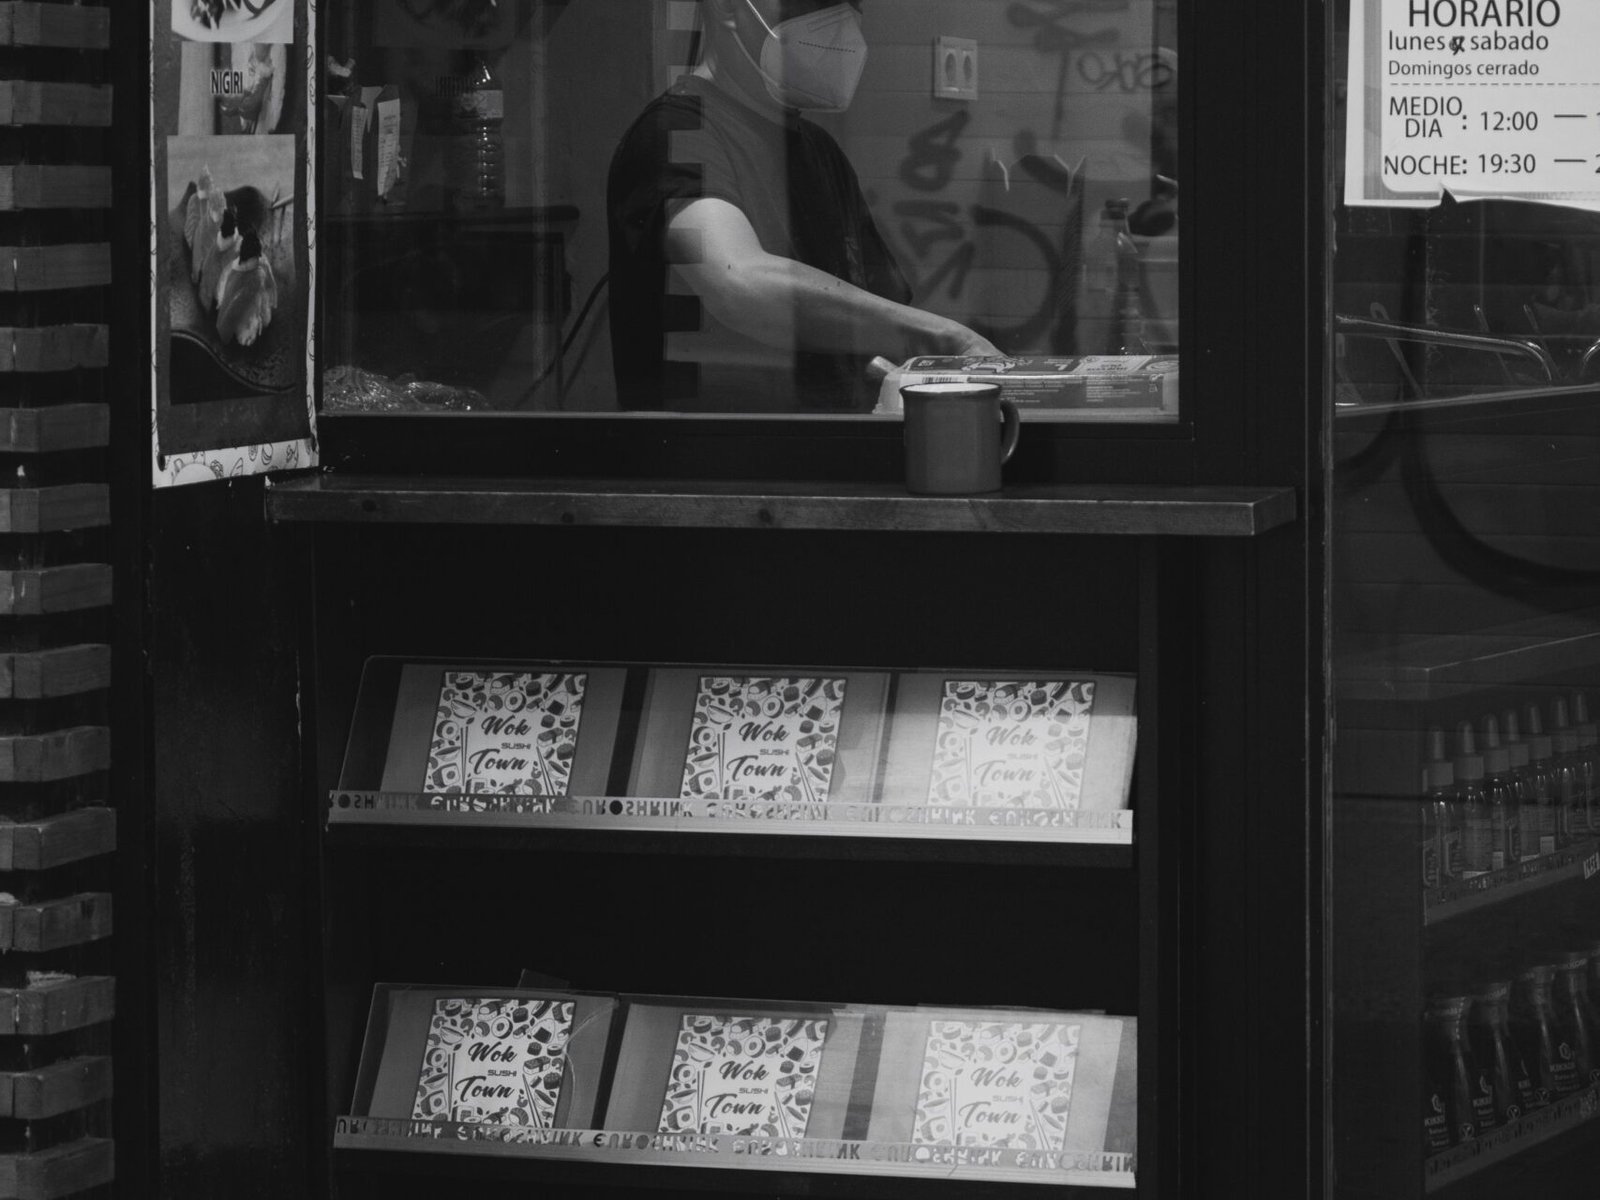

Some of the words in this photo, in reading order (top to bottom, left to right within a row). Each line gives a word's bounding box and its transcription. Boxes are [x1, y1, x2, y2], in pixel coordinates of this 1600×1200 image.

[1388, 29, 1446, 51] lunes
[1470, 29, 1550, 51] sabado
[1388, 59, 1472, 80] Domingos
[1477, 59, 1540, 76] cerrado
[211, 70, 244, 95] NIGIRI
[1389, 95, 1463, 116] MEDIO
[1405, 118, 1443, 138] DIA
[1480, 111, 1539, 131] 12:00
[1478, 153, 1536, 174] 19:30
[481, 714, 532, 736] Wok
[739, 720, 790, 742] Wok
[986, 724, 1038, 746] Wok
[468, 748, 529, 775] Town
[726, 754, 787, 782] Town
[974, 759, 1035, 787] Town
[467, 1041, 518, 1063] Wok
[718, 1059, 770, 1081] Wok
[970, 1066, 1024, 1088] Wok
[454, 1075, 515, 1102] Town
[704, 1093, 766, 1119] Town
[958, 1101, 1022, 1129] Town
